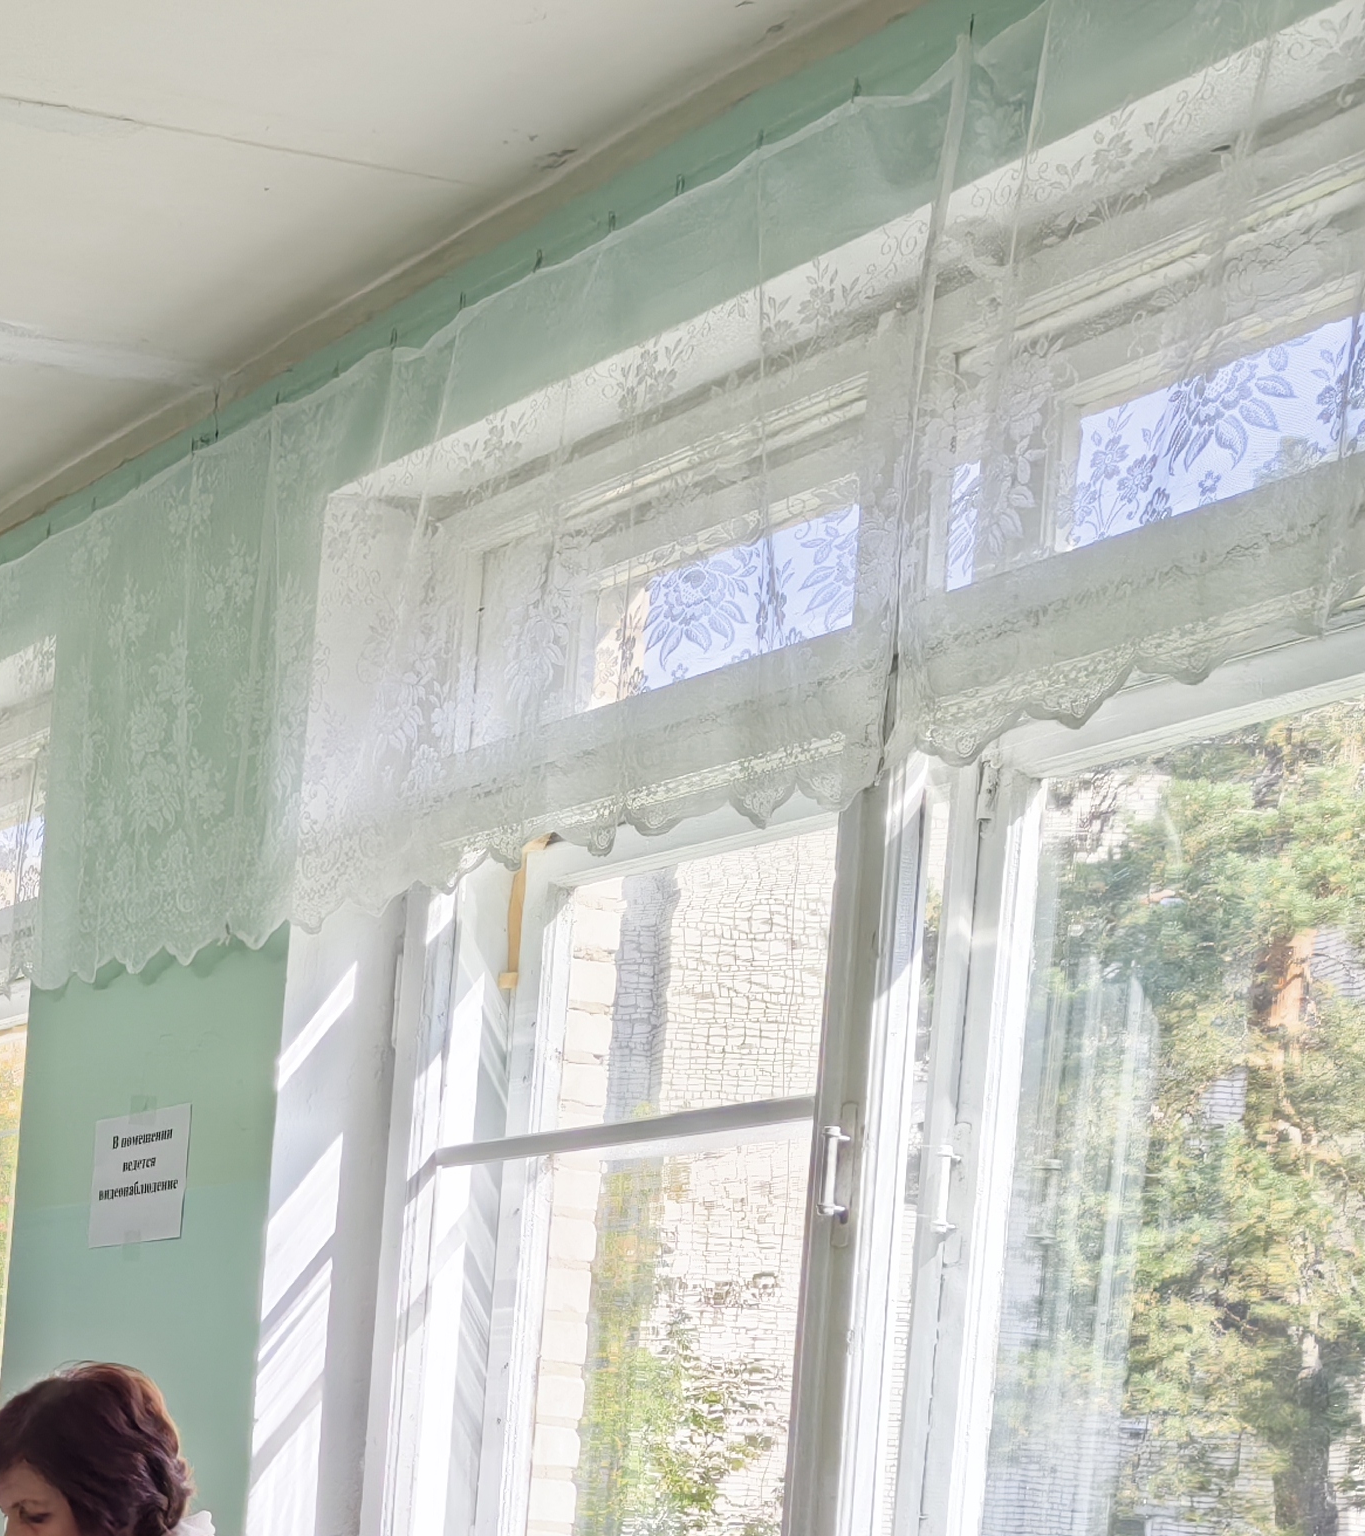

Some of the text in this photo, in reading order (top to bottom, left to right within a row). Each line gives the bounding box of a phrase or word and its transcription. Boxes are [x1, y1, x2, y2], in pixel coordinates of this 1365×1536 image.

[112, 1135, 119, 1149] В
[122, 1157, 156, 1172] ведется
[98, 1179, 178, 1201] видеонаблюдение
